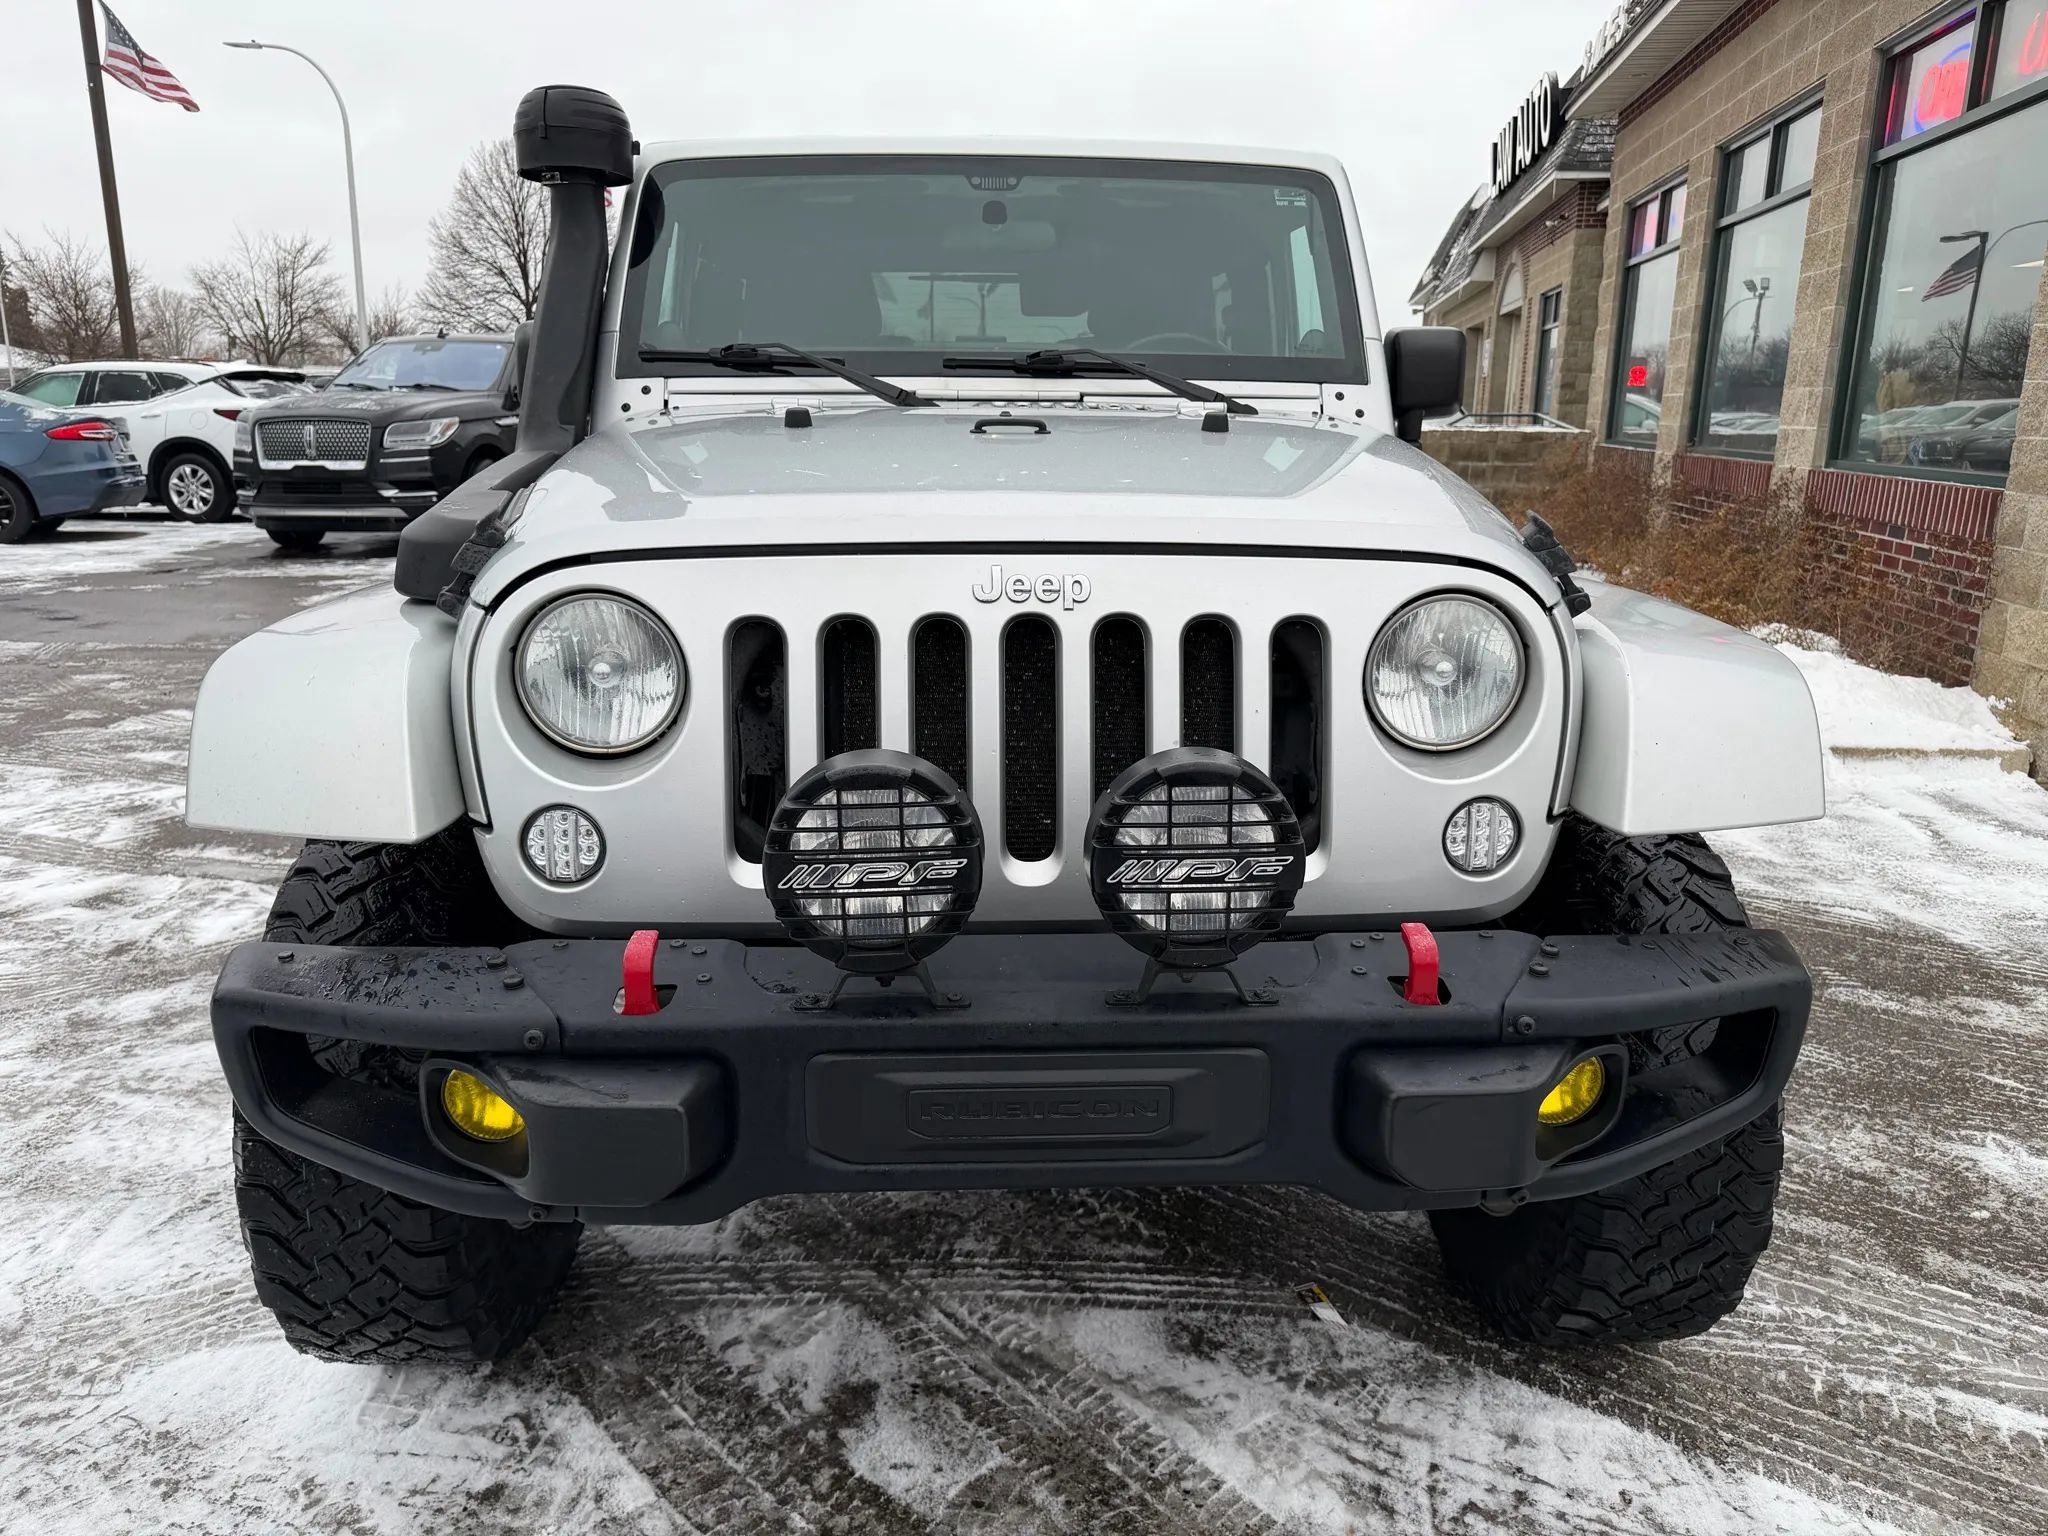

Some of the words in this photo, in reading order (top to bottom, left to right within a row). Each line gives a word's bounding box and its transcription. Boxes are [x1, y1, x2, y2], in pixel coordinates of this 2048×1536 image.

[1489, 116, 1515, 199] LAW
[1515, 71, 1553, 176] AUTO
[972, 565, 1091, 611] Jeep
[920, 1099, 1159, 1120] RUBICON
